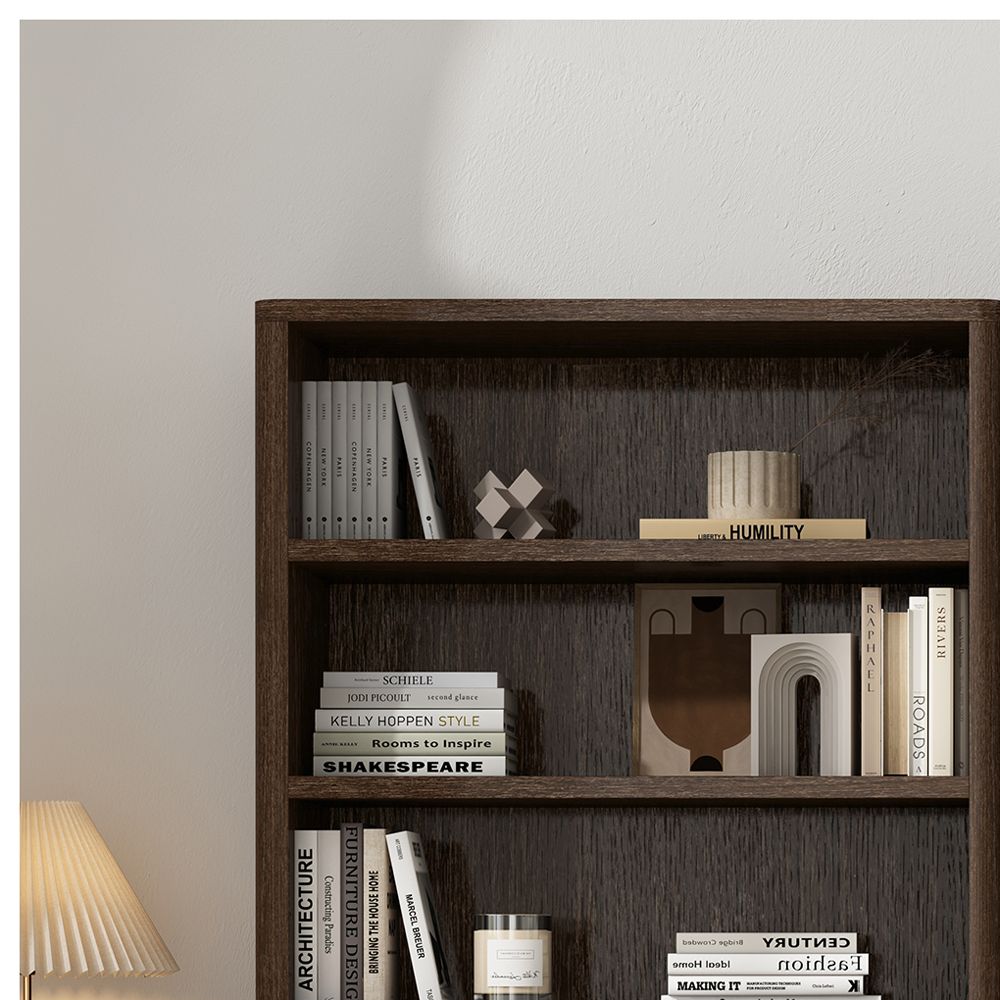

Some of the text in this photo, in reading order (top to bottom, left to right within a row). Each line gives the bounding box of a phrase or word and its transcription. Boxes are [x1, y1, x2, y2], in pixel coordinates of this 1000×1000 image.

[413, 457, 422, 478] PARIS
[729, 524, 804, 540] HUMILITY
[936, 606, 946, 659] RIVERS
[866, 604, 876, 693] RAPHAEL
[383, 675, 434, 685] SCHIELE
[347, 693, 412, 703] JODI PICOULT
[427, 693, 479, 702] second glance
[330, 716, 480, 727] KELLY HOPPEN STYLE
[913, 695, 926, 760] ROADS
[372, 739, 492, 750] Rooms to Inspire
[323, 761, 483, 773] SHAKESPEARE
[345, 826, 358, 938] FURNITURE
[322, 875, 334, 922] Constructing
[297, 848, 314, 992] ARCHITECTURE
[369, 870, 379, 974] BRINGING THE HOUSE HOME
[405, 893, 426, 959] MARCEL BREUER
[677, 981, 741, 991] MAKING IT
